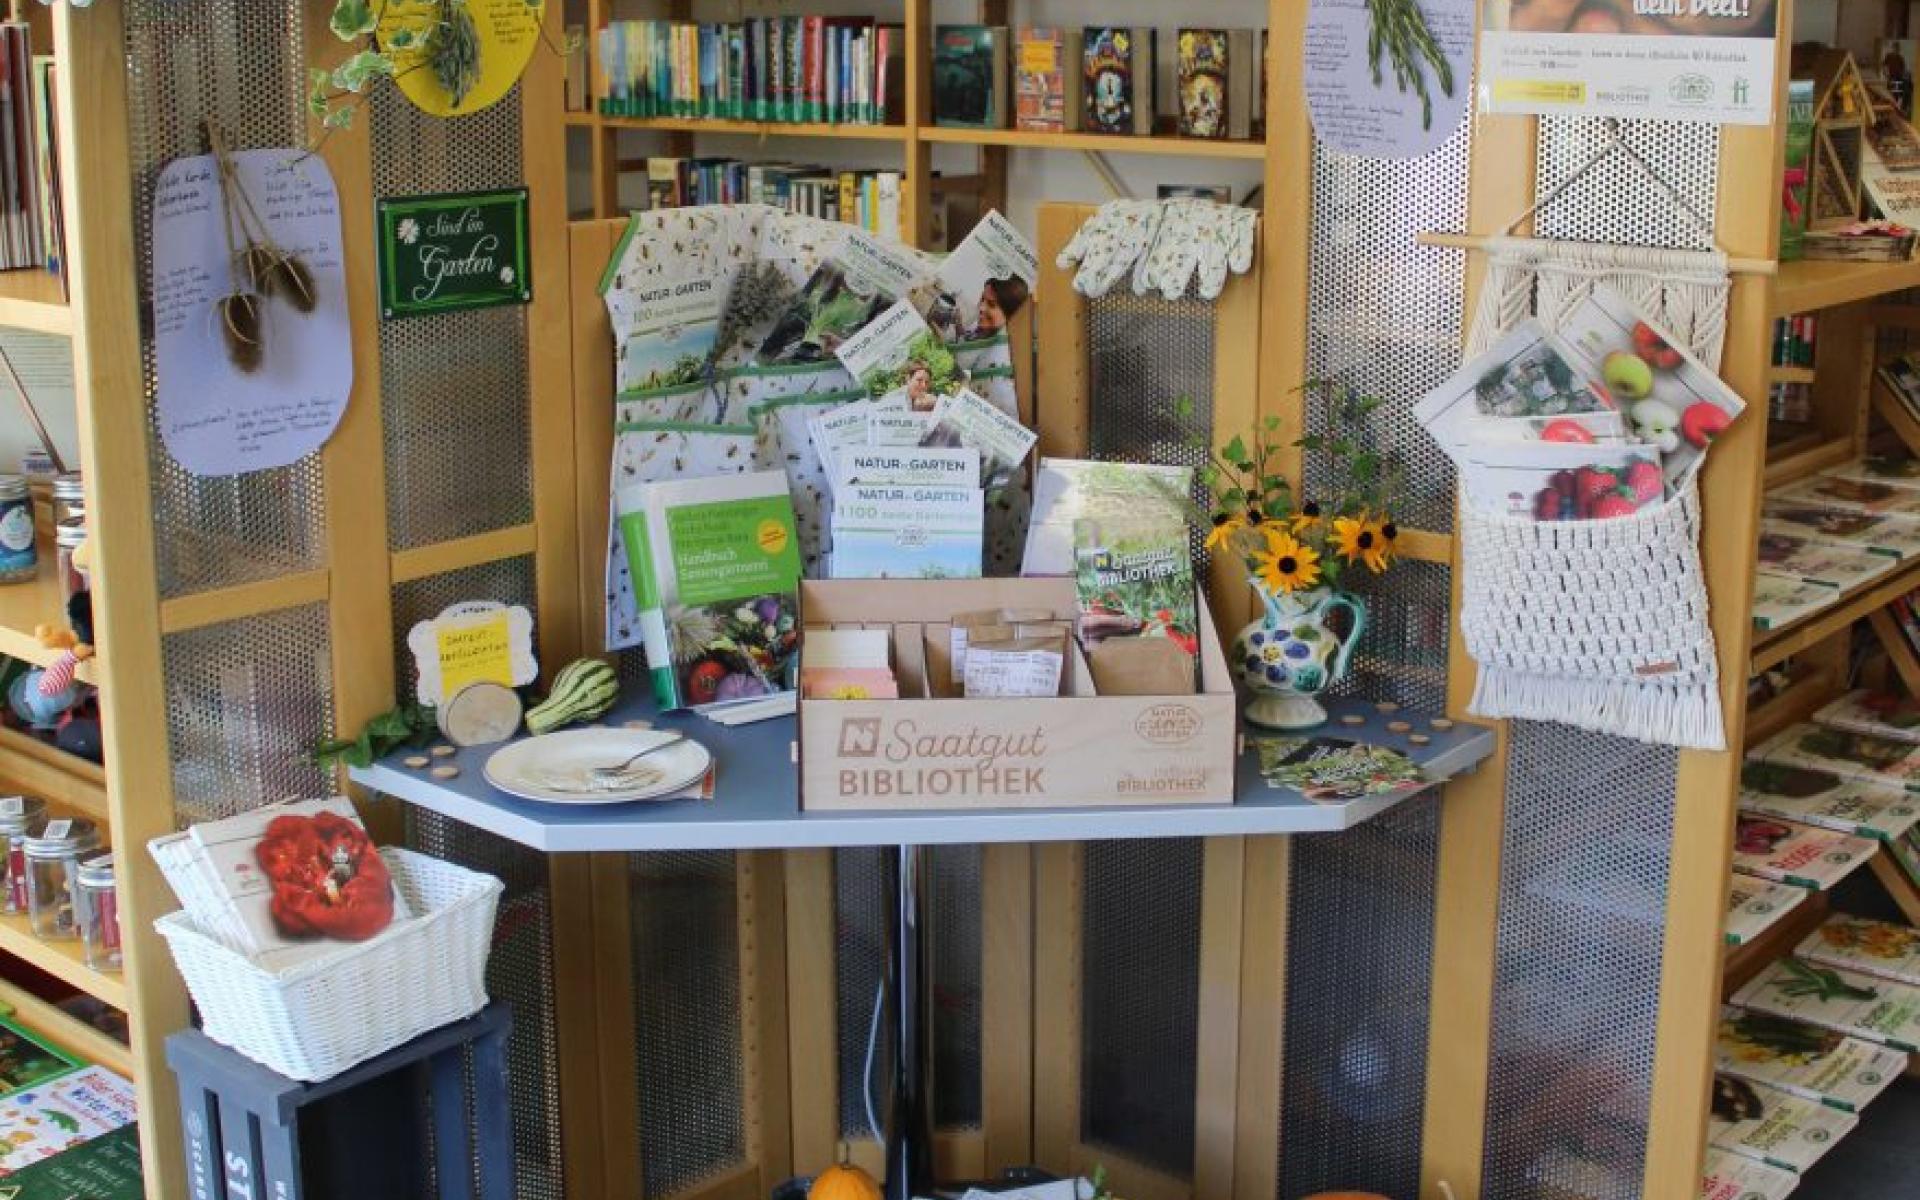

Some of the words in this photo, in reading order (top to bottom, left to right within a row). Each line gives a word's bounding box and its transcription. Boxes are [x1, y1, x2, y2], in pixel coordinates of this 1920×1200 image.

[413, 234, 499, 303] Garten
[854, 457, 901, 470] NATUR
[909, 458, 966, 472] GARTEN
[857, 488, 905, 501] NATUR
[913, 490, 971, 503] GARTEN
[885, 719, 1047, 771] Saatgut
[839, 767, 1046, 797] BIBLIOTHEK
[1117, 778, 1206, 792] BIBLIOTHEK
